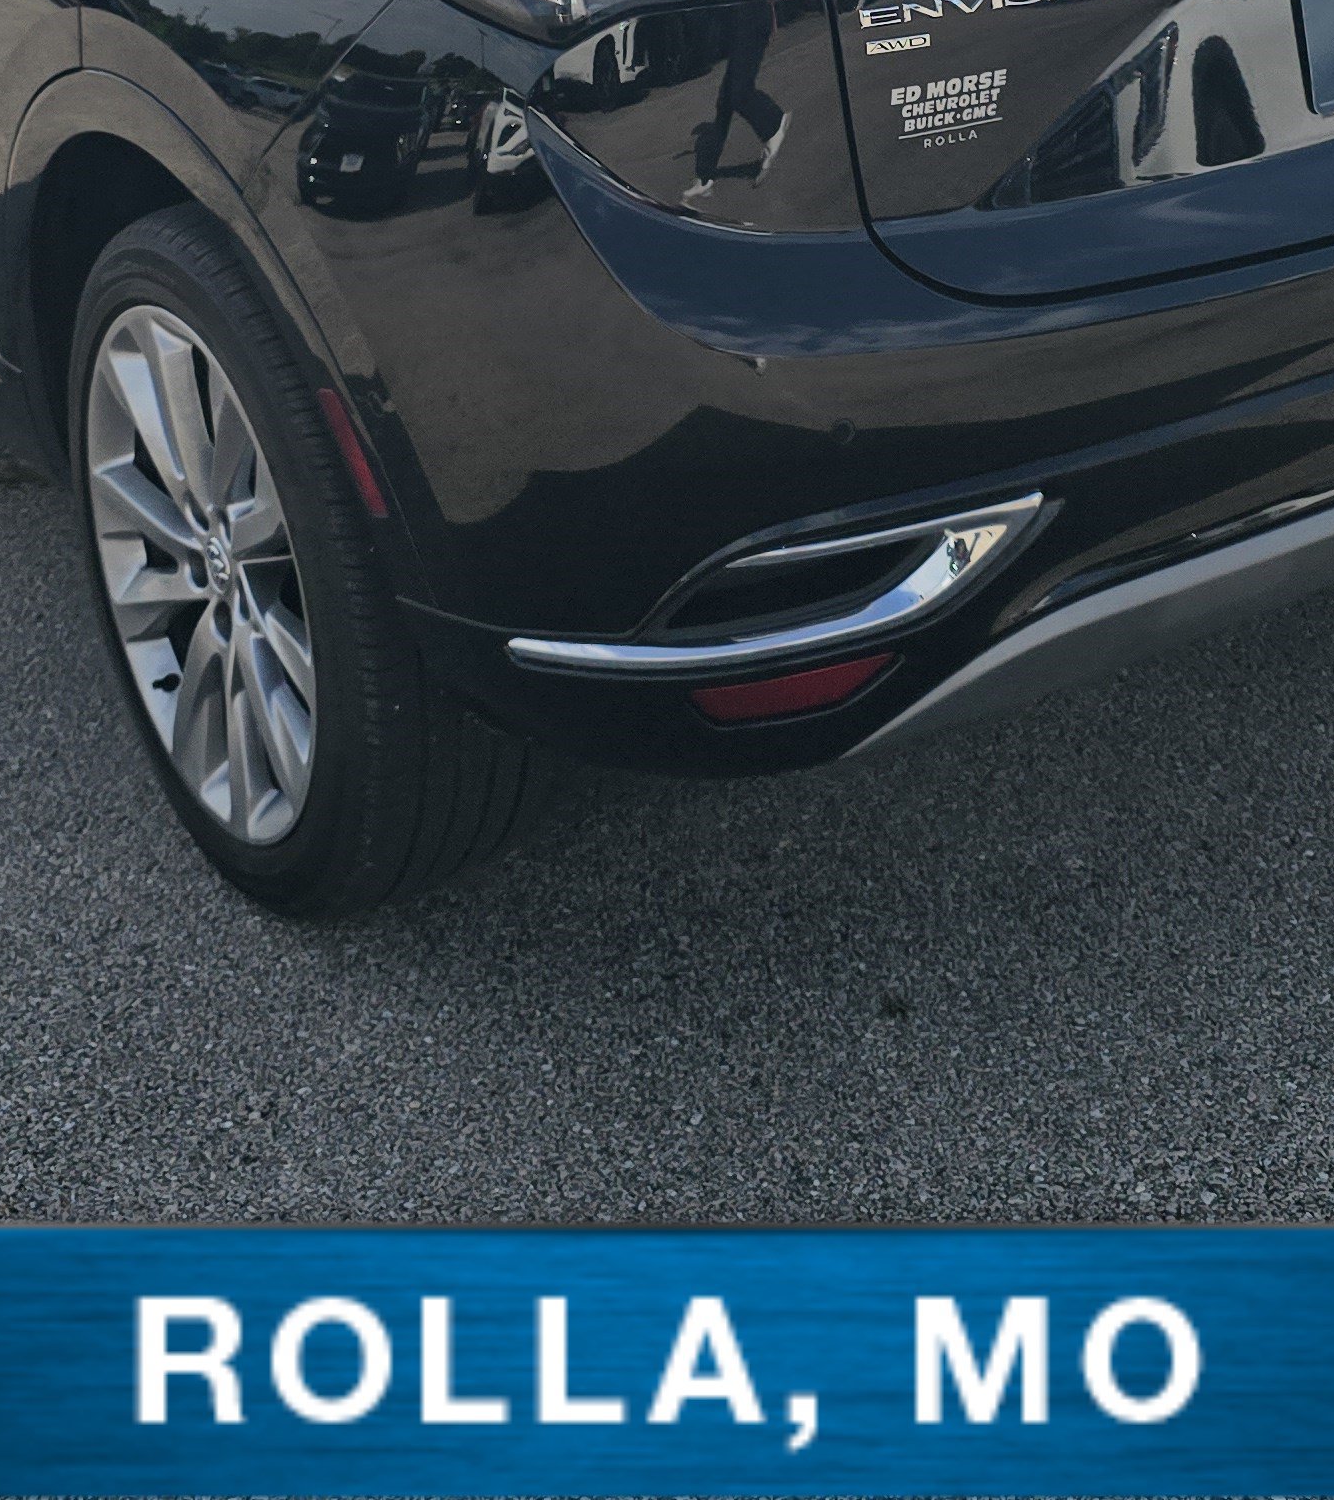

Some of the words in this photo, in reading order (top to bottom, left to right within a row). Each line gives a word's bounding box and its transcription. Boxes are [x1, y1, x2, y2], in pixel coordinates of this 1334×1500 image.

[868, 34, 929, 54] AWD
[890, 84, 922, 106] ED
[926, 68, 1008, 100] MORSE
[901, 87, 1001, 119] CHEVROLET
[923, 128, 979, 149] ROLLA
